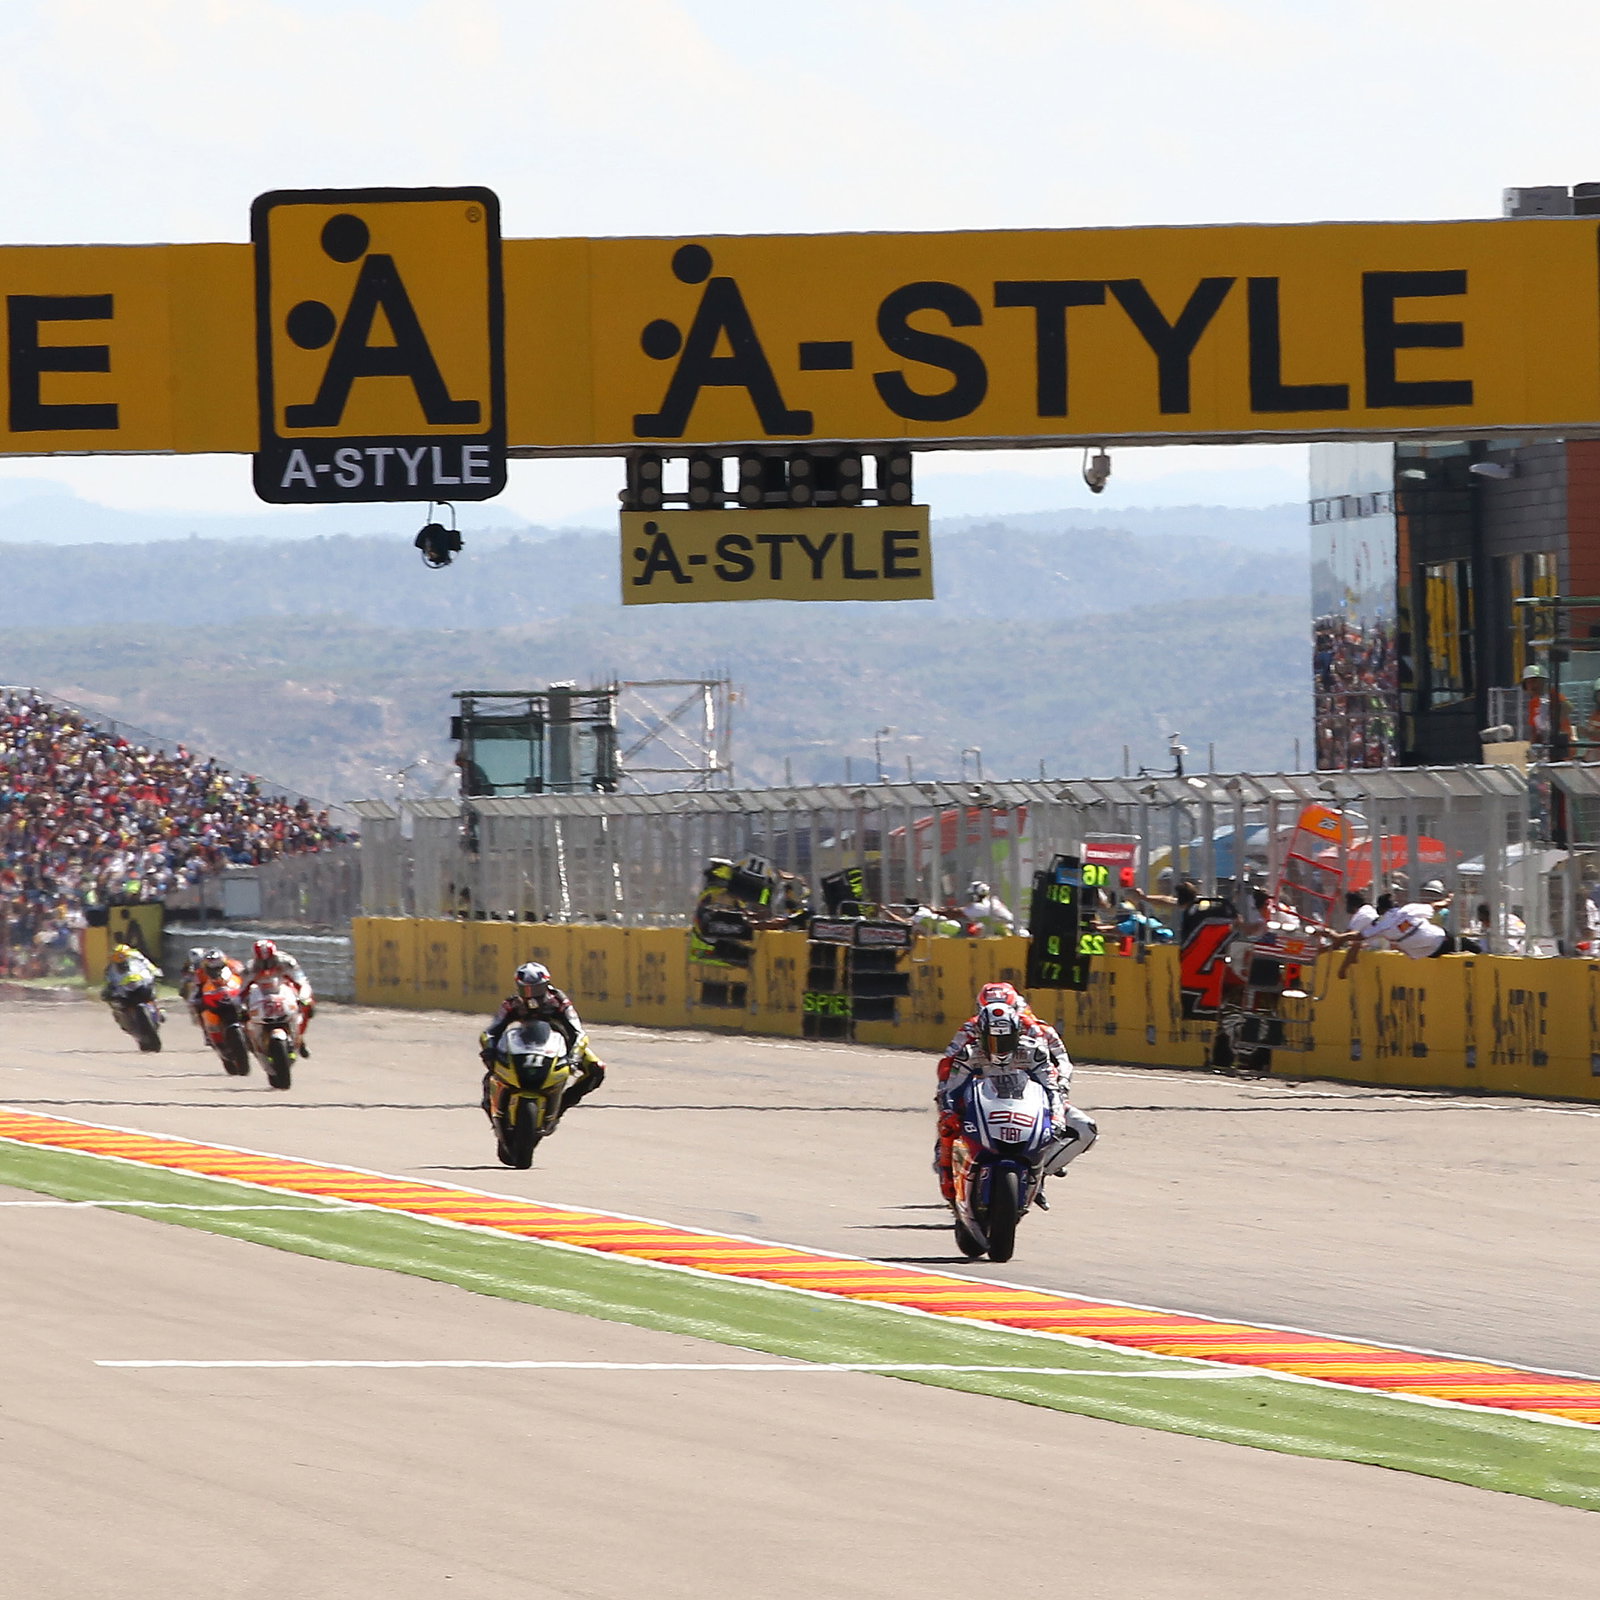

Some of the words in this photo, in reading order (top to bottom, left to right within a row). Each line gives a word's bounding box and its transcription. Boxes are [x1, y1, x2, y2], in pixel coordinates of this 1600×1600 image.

[632, 268, 1475, 439] A-STYLE
[280, 444, 493, 489] A-STYLE
[631, 528, 923, 587] A-STYLE
[988, 1111, 1036, 1128] 99
[1001, 1127, 1022, 1142] FIAT
